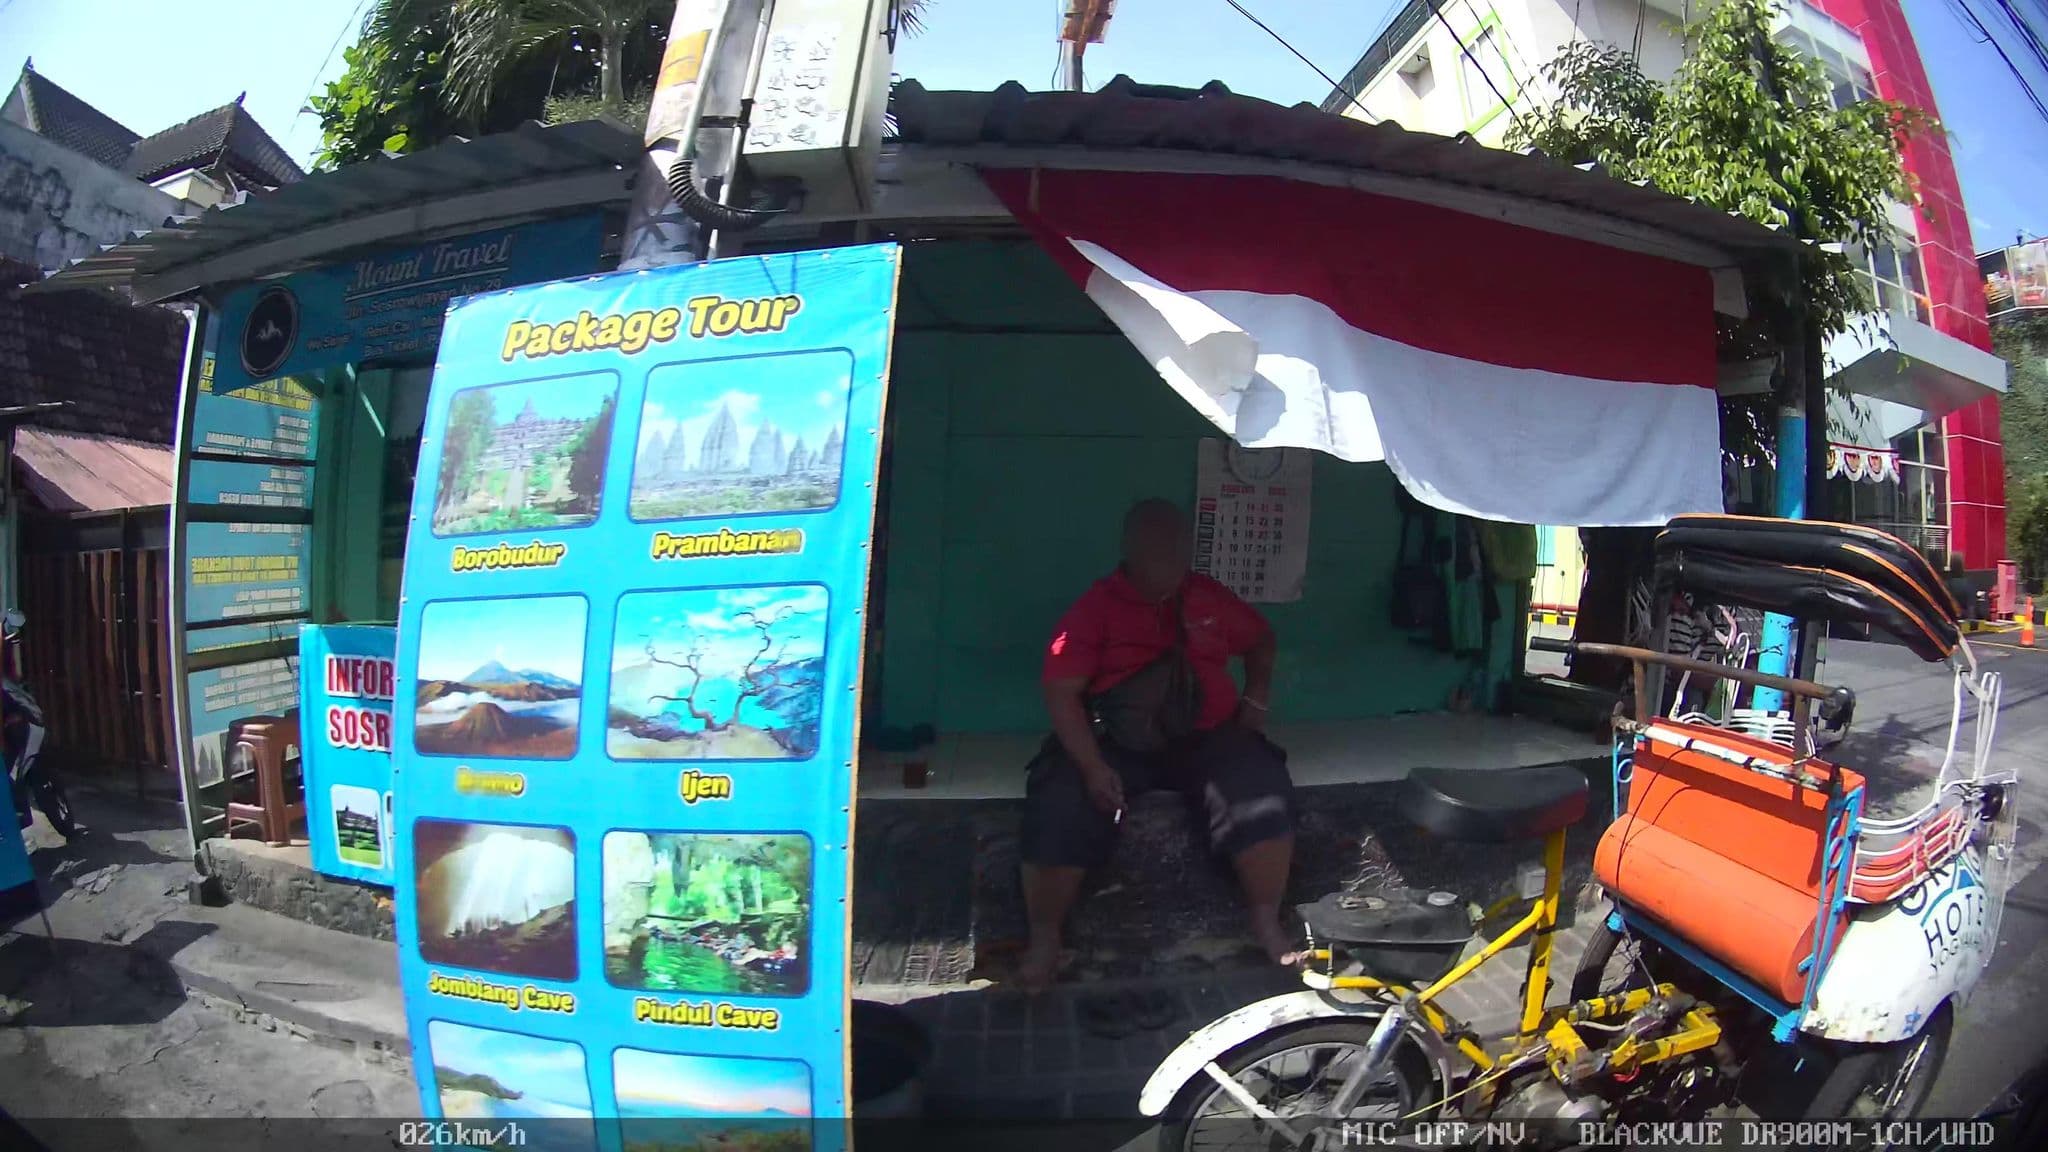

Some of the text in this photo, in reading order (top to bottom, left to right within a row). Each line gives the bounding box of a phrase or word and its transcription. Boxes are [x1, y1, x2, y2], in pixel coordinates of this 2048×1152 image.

[348, 236, 510, 290] Mount Travel
[502, 296, 800, 362] Package Tour
[452, 542, 564, 571] Borobudur
[653, 529, 801, 559] Prambanan
[680, 770, 730, 804] Ijen
[429, 974, 574, 1012] Jomblang Cave
[635, 999, 778, 1029] Pindul Cave
